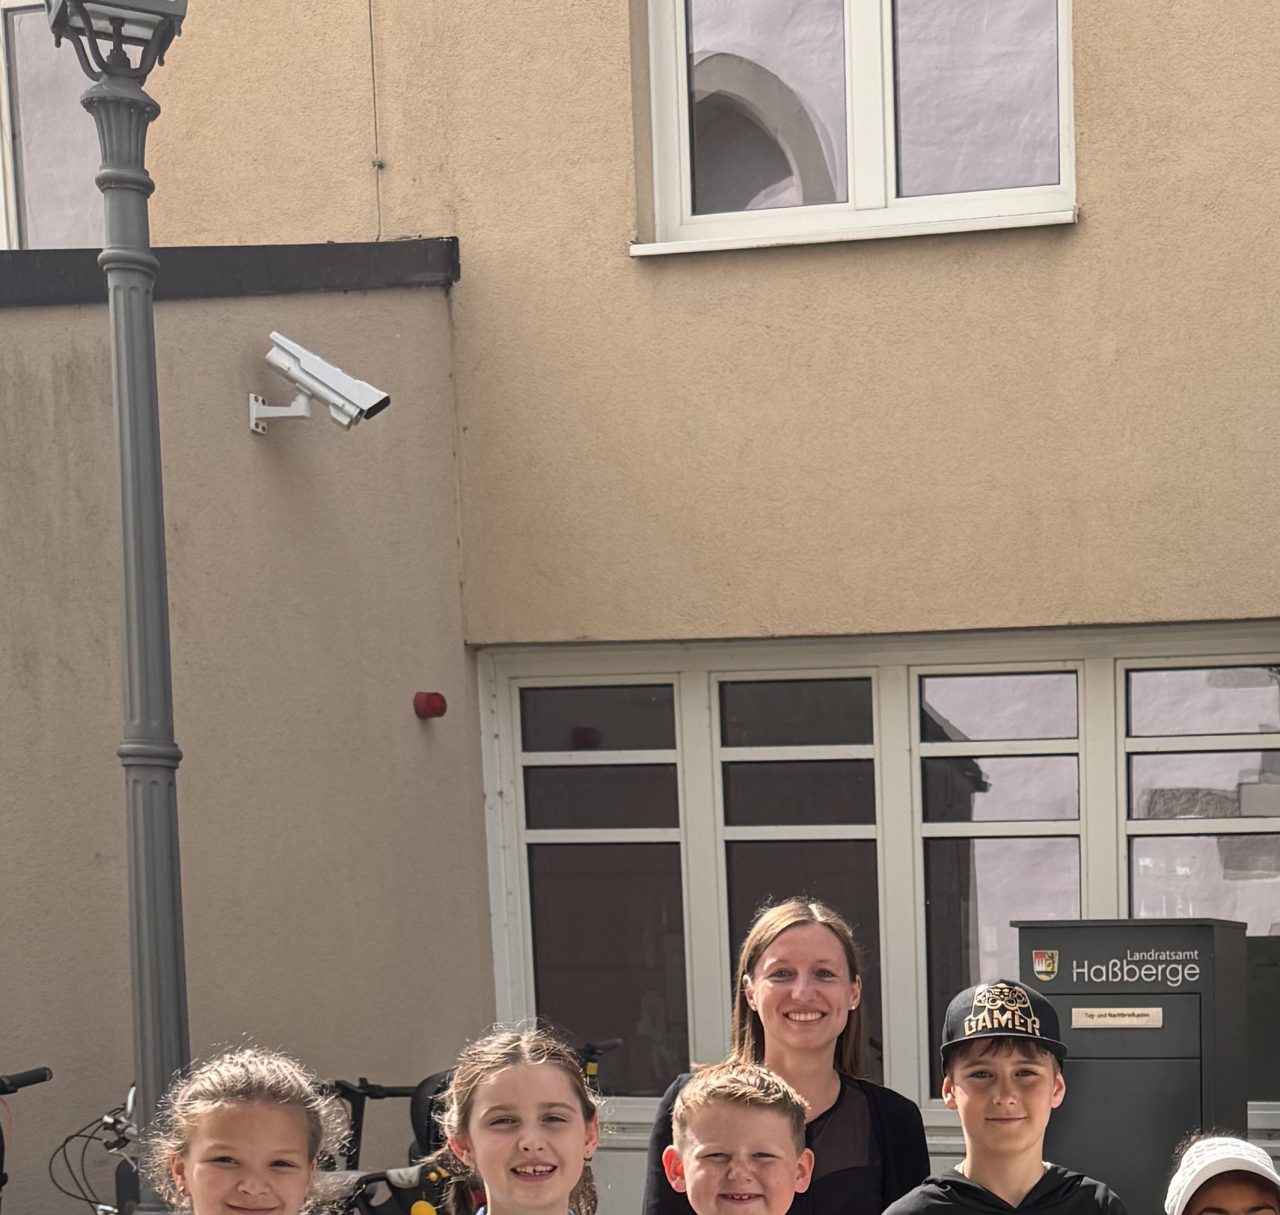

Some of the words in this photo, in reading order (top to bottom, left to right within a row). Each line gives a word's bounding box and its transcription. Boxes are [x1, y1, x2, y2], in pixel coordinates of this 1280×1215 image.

[1127, 949, 1199, 961] Landratsamt
[1072, 958, 1200, 988] Haßberge
[963, 1009, 1041, 1037] GAMER
